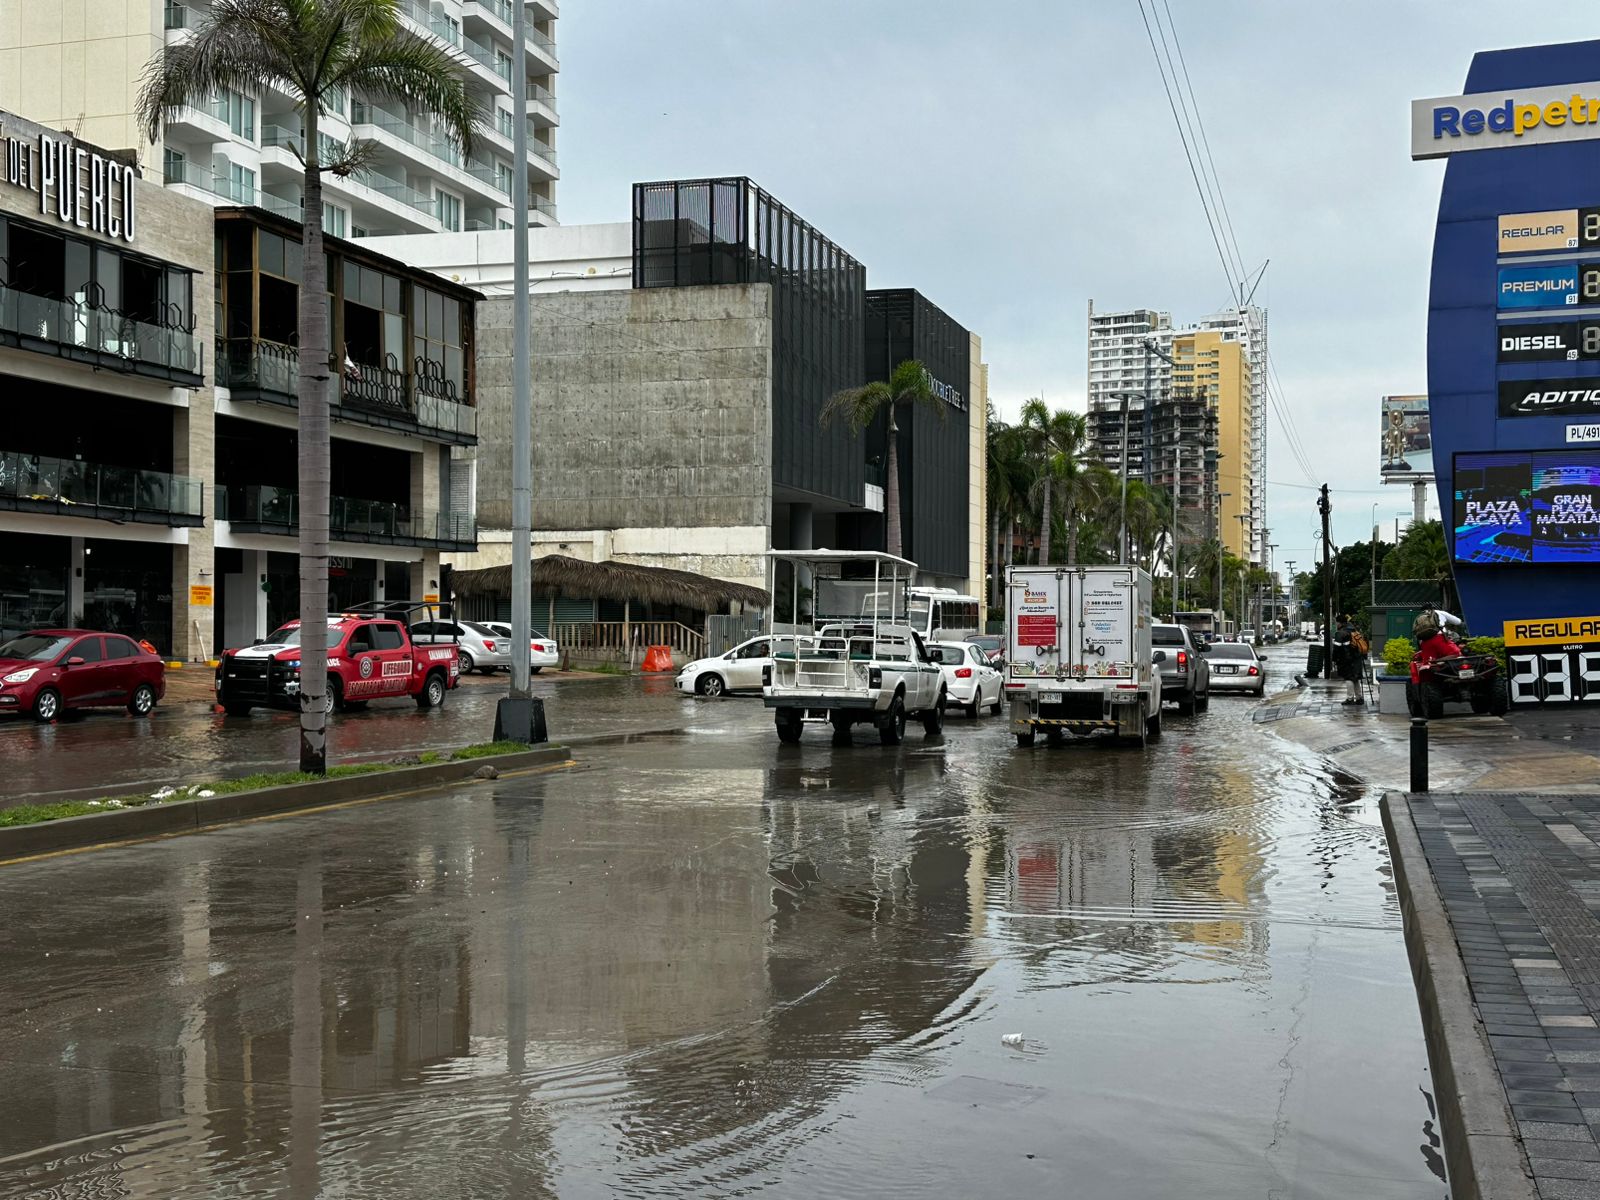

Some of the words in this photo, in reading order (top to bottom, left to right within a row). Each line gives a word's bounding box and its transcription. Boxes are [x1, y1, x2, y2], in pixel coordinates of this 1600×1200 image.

[8, 136, 38, 192] DEL
[40, 134, 135, 242] PUERCO
[1502, 225, 1565, 238] REGULAR
[1568, 239, 1577, 247] 87
[1502, 279, 1574, 293] PREMIUM
[1568, 295, 1577, 303] 91
[1501, 335, 1567, 352] DIESEL
[1553, 494, 1592, 505] GRAN
[1465, 500, 1521, 514] PLAZA
[1551, 504, 1598, 514] PLAZA
[1463, 512, 1523, 526] ACAYA
[1536, 513, 1600, 525] MAZATLA
[383, 661, 412, 675] LIFEGUARD
